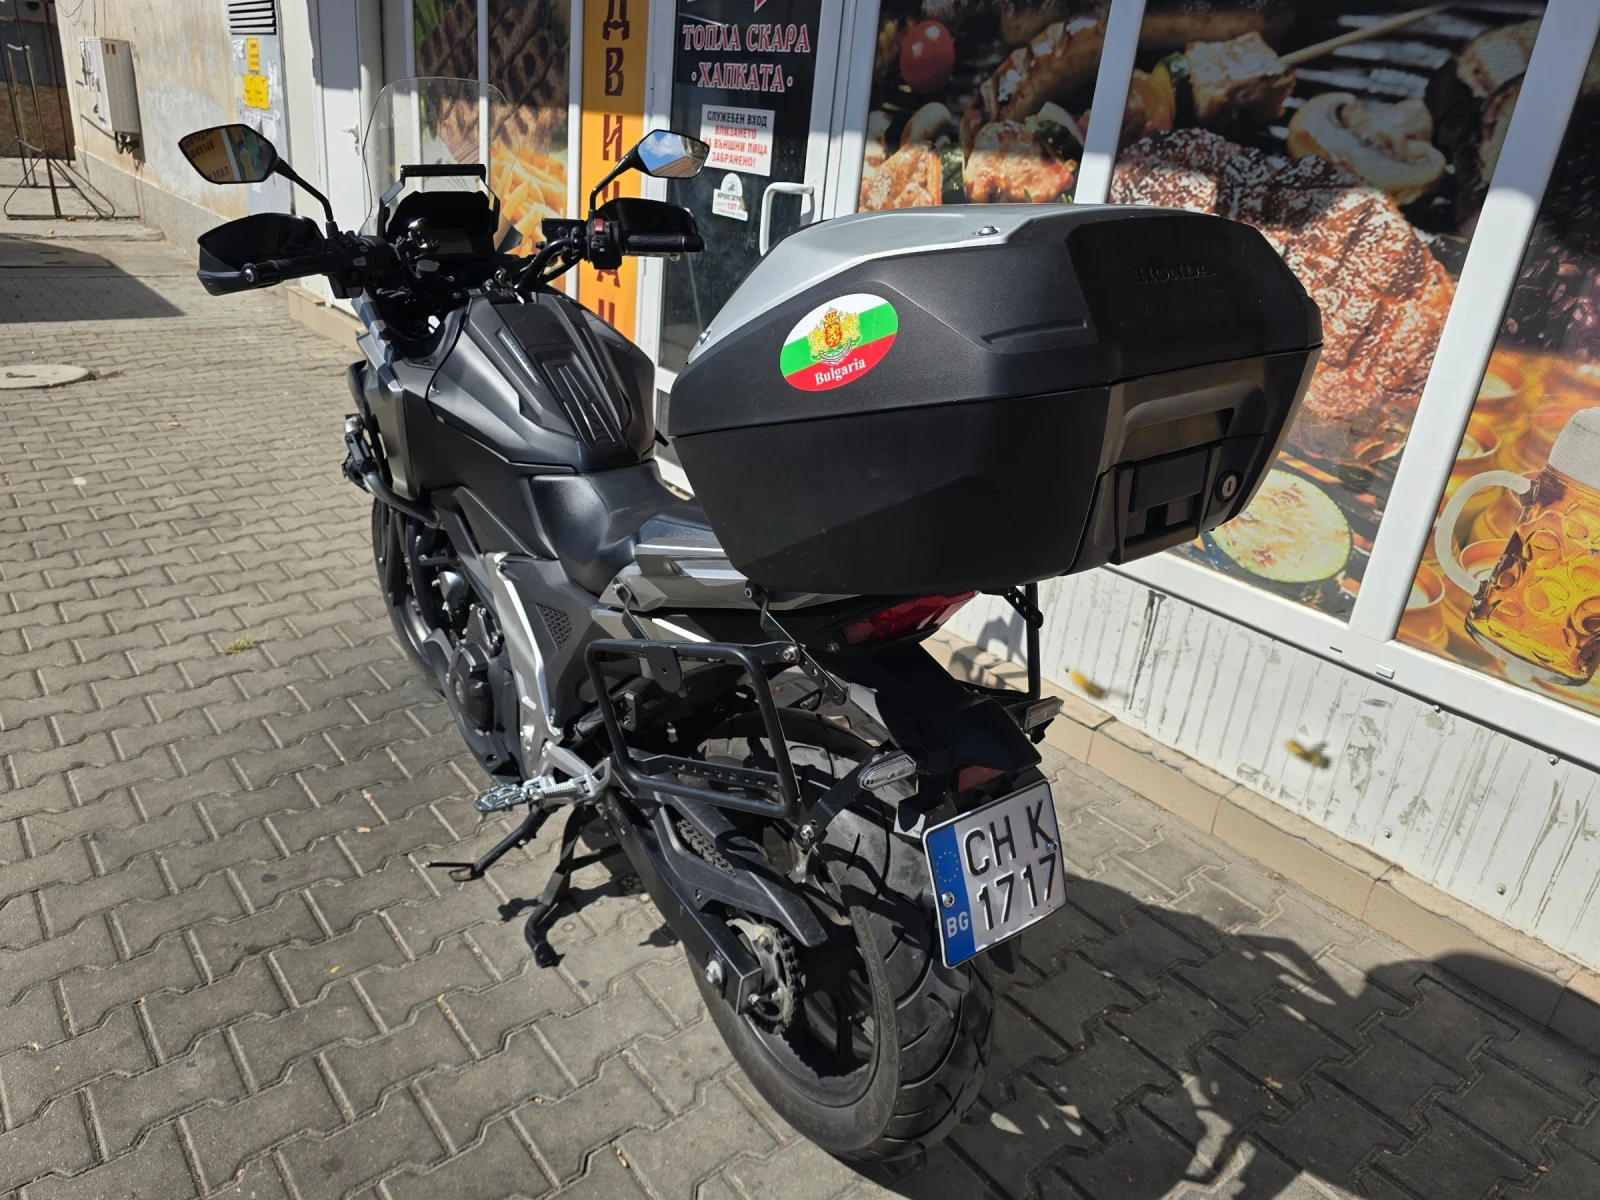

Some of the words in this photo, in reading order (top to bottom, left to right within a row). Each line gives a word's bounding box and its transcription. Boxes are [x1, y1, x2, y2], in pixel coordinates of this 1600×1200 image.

[682, 24, 741, 51] ТОПЛА
[745, 23, 811, 53] СКАРА
[707, 110, 745, 124] СЛУЖЕБЕН
[747, 115, 768, 128] ВХОД
[714, 125, 757, 139] ВЛИЗАНЕТО
[711, 152, 756, 168] ЗАБРАНЕНО!
[714, 139, 745, 152] ВЪНШНИ
[747, 143, 768, 156] ЛИЦА
[814, 358, 866, 386] Bulgaria
[963, 814, 1017, 877] CH
[976, 854, 1056, 931] 1717
[946, 911, 969, 938] BG
